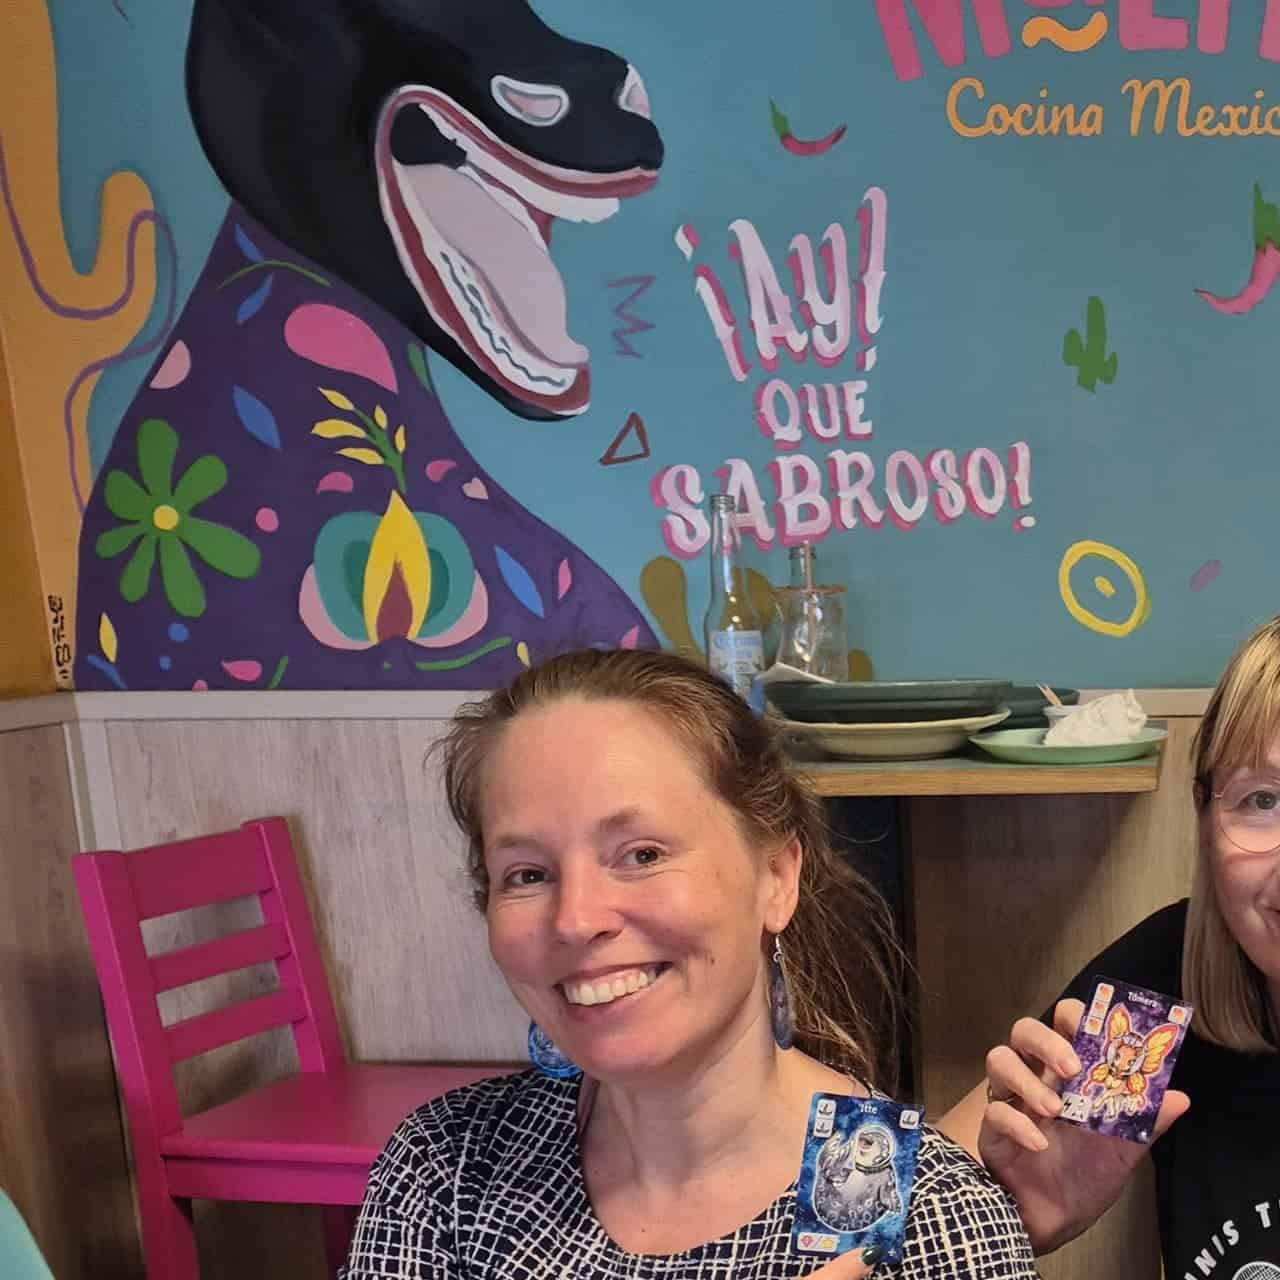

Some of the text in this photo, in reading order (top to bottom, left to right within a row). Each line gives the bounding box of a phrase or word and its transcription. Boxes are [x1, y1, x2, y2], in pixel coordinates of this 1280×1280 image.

[945, 76, 1105, 138] Cocina
[755, 378, 874, 451] QUE
[650, 440, 1037, 561] SABROSO!
